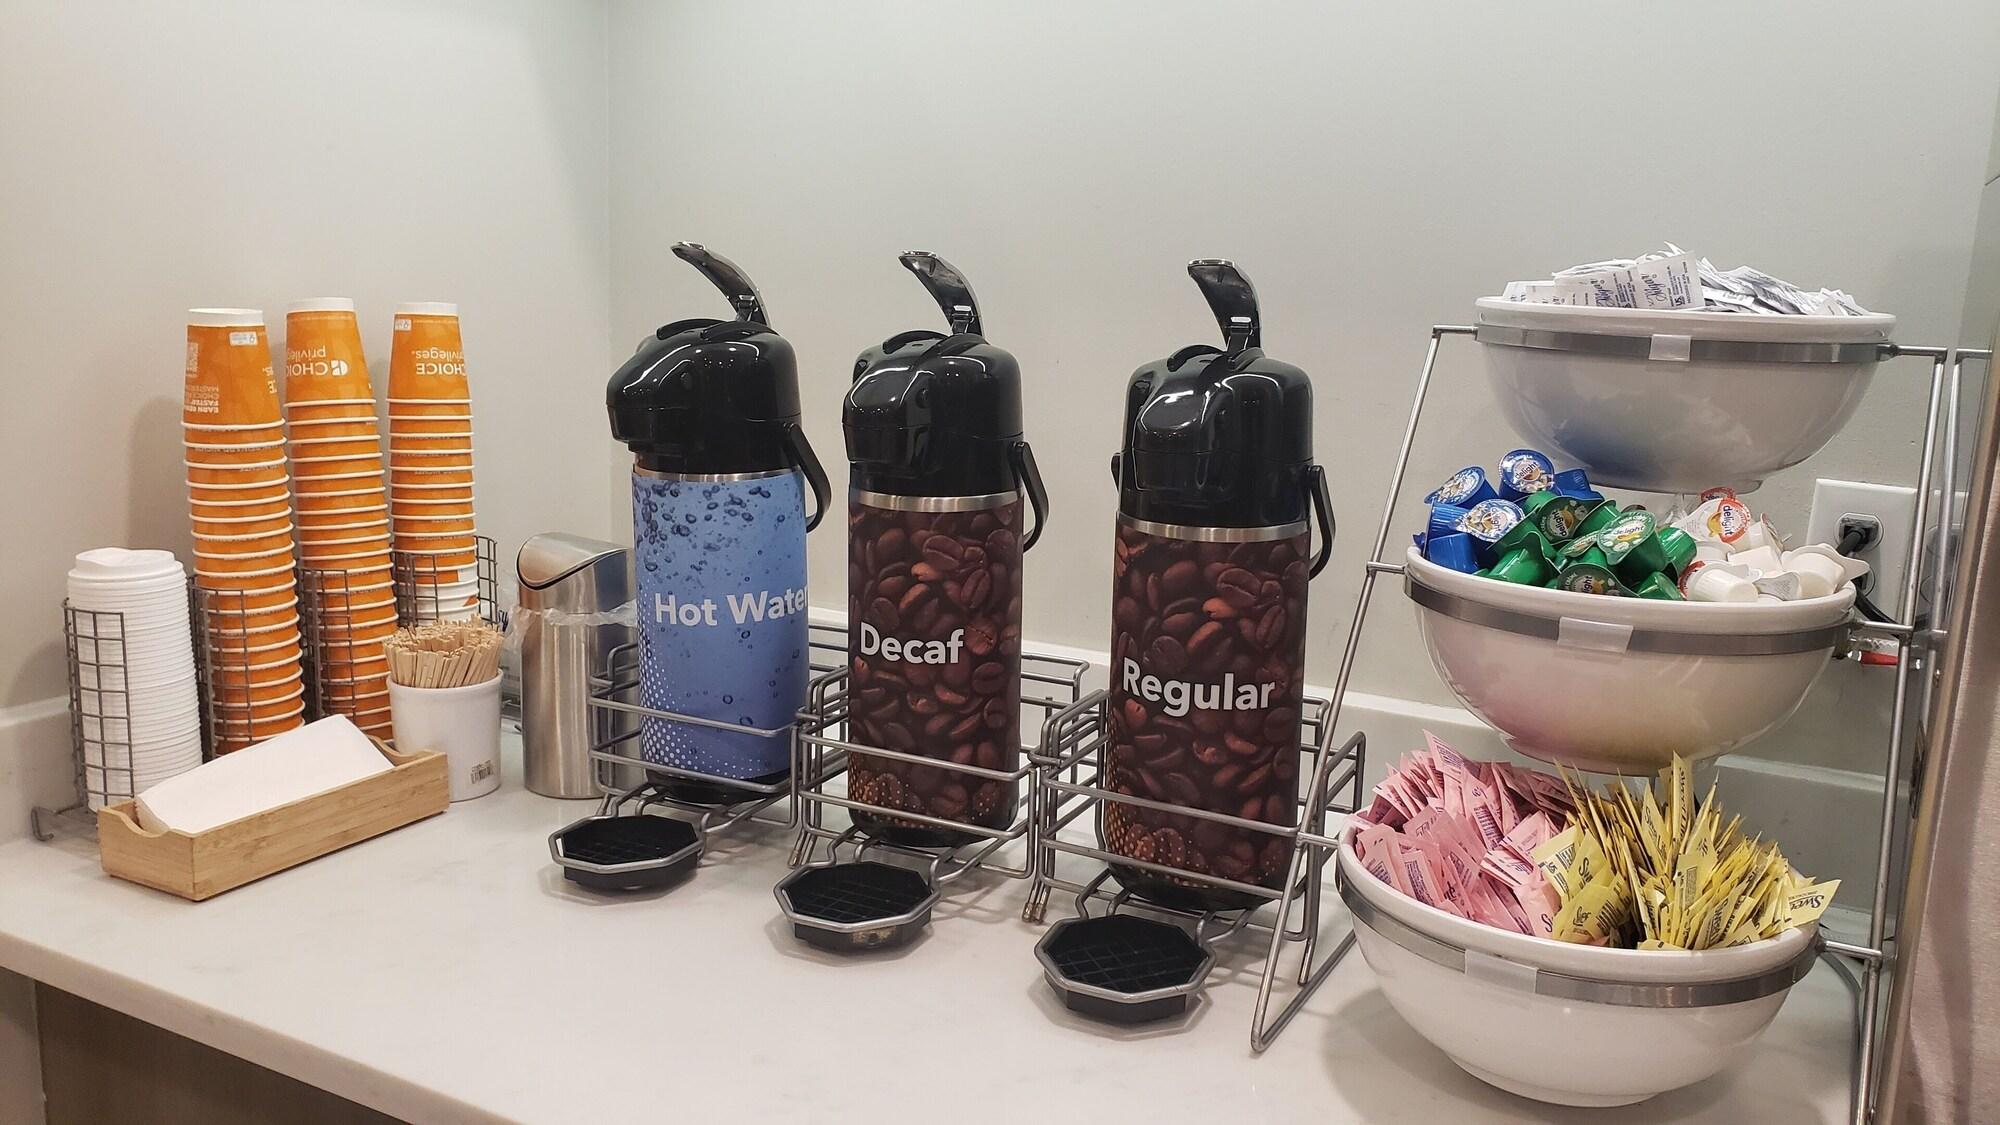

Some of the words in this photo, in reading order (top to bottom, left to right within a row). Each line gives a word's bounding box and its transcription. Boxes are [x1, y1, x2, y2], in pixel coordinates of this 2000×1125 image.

[1515, 462, 1538, 479] delight
[1552, 509, 1567, 537] delight
[1613, 525, 1645, 536] delight
[1722, 505, 1735, 536] delight
[655, 592, 718, 626] Hot
[861, 621, 965, 665] Decaf
[1123, 656, 1276, 717] Regular
